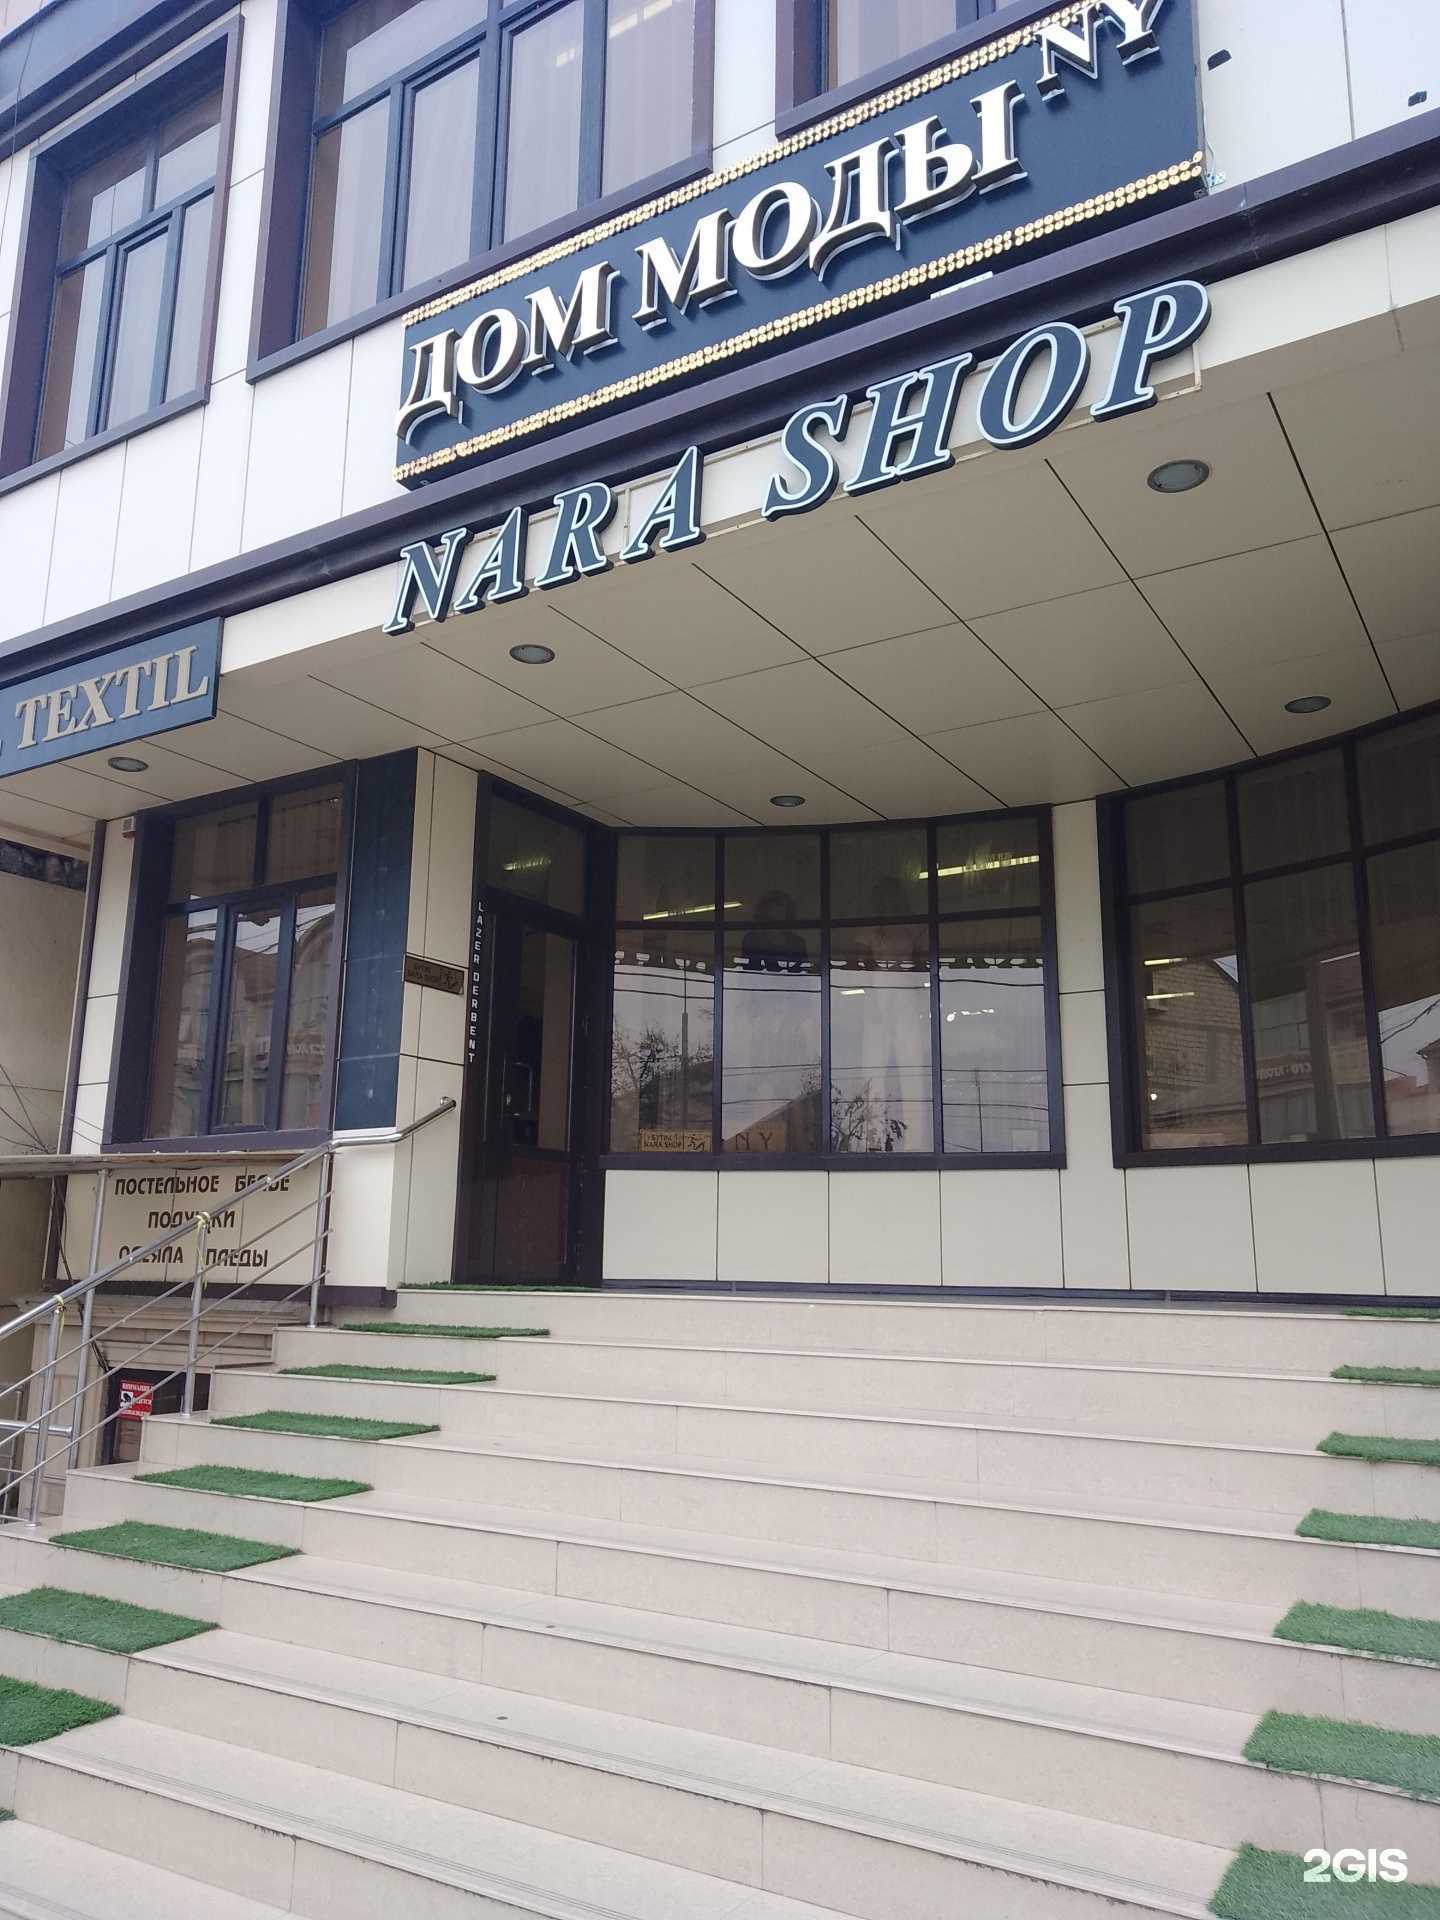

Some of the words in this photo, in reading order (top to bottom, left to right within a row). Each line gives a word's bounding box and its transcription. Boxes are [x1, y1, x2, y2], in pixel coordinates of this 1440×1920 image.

[1034, 0, 1168, 101] NY
[388, 262, 618, 443] ДОМ
[631, 80, 1027, 330] МОДЫ
[383, 446, 707, 635] NARA
[762, 279, 1213, 521] SHOP
[15, 645, 209, 749] TEXTIL
[473, 901, 485, 964] LAZER
[468, 971, 480, 1063] DERBENT
[114, 1175, 220, 1195] ПОСТЕЛЬНОЕ
[234, 1174, 290, 1193] БЕЬЕ
[148, 1210, 235, 1232] ПОДУКИ
[206, 1248, 268, 1267] ПЛЕДЫ
